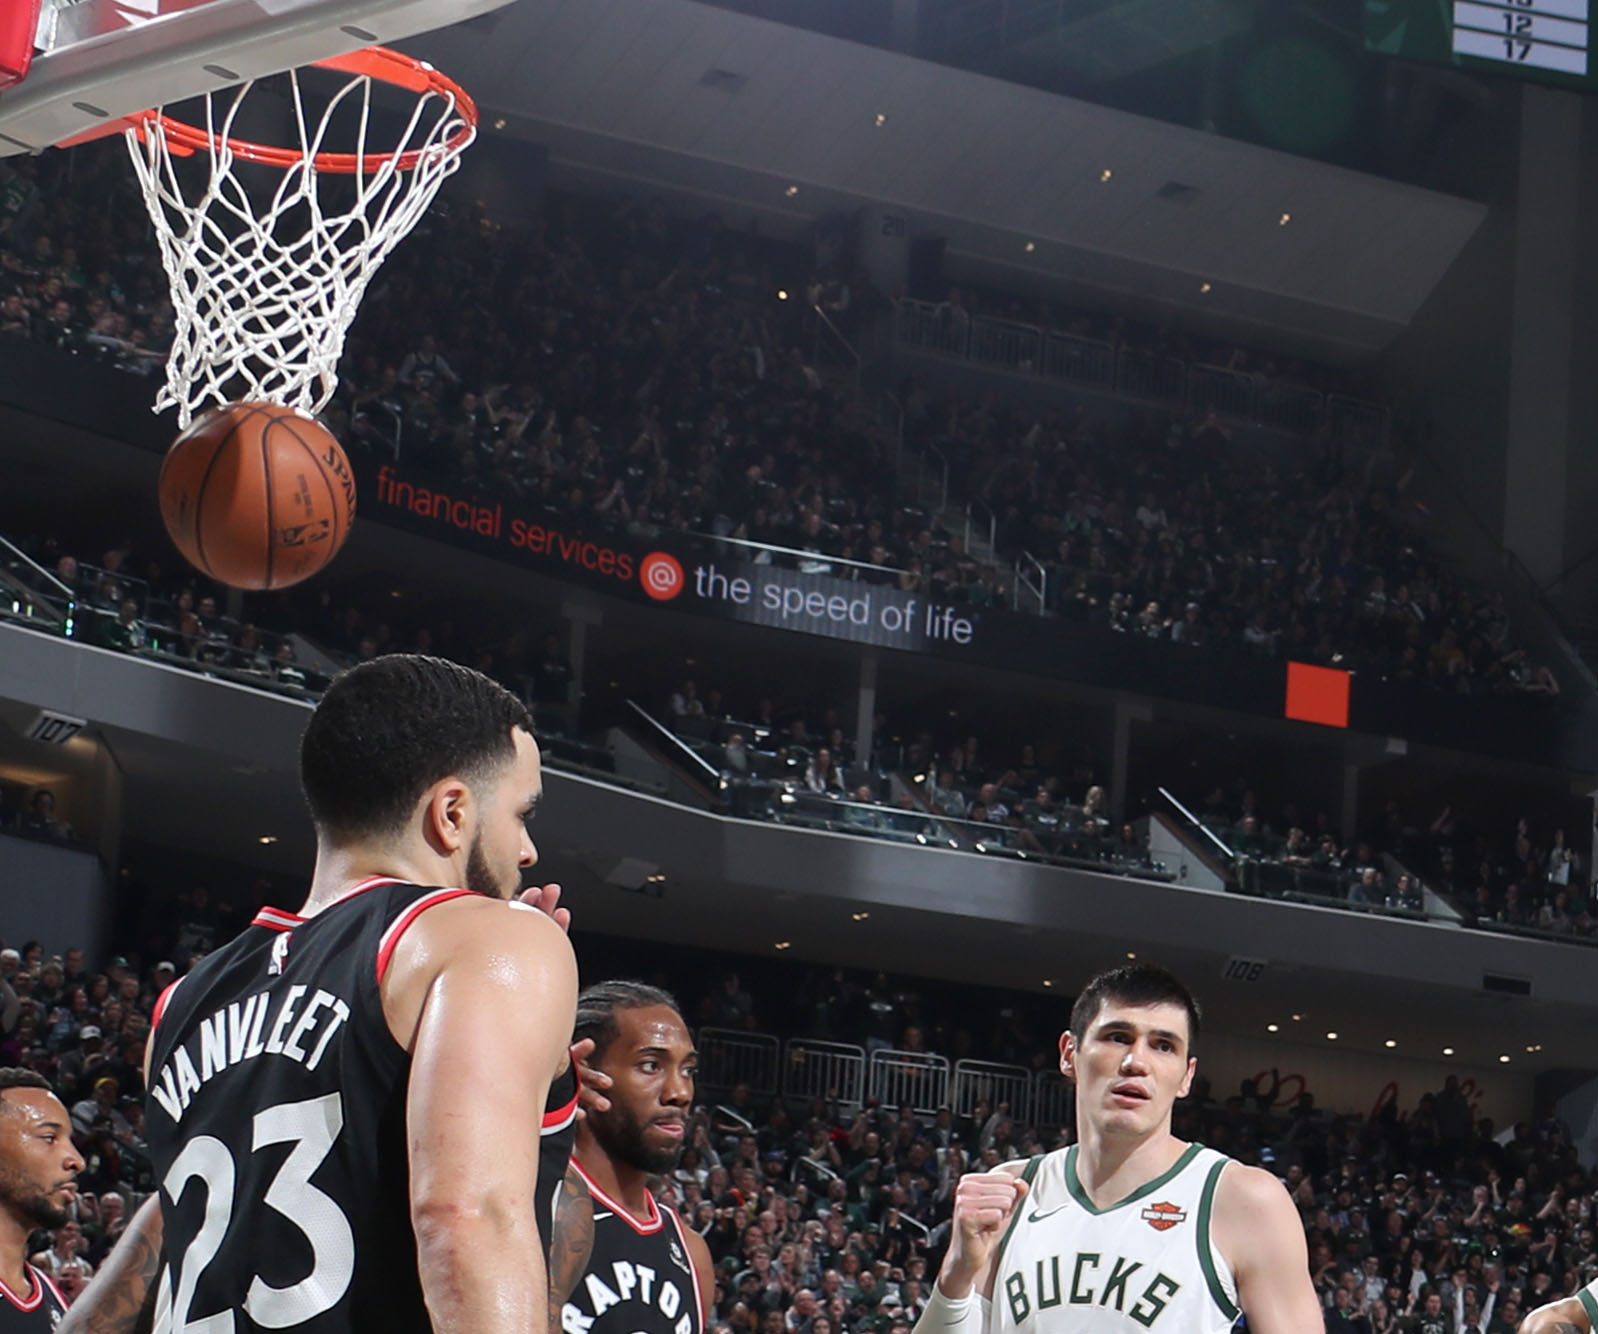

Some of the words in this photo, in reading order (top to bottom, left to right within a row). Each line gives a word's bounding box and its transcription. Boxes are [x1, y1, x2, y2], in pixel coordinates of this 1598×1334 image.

[1503, 14, 1532, 39] 12
[1503, 39, 1532, 60] 17
[376, 466, 502, 538] financial
[508, 519, 634, 580] services
[695, 565, 751, 604] the
[763, 583, 870, 624] speed
[881, 600, 916, 633] of
[925, 603, 973, 644] life
[31, 716, 82, 744] 107
[152, 984, 350, 1123] VANVLEET
[1004, 1252, 1181, 1328] BUCKS
